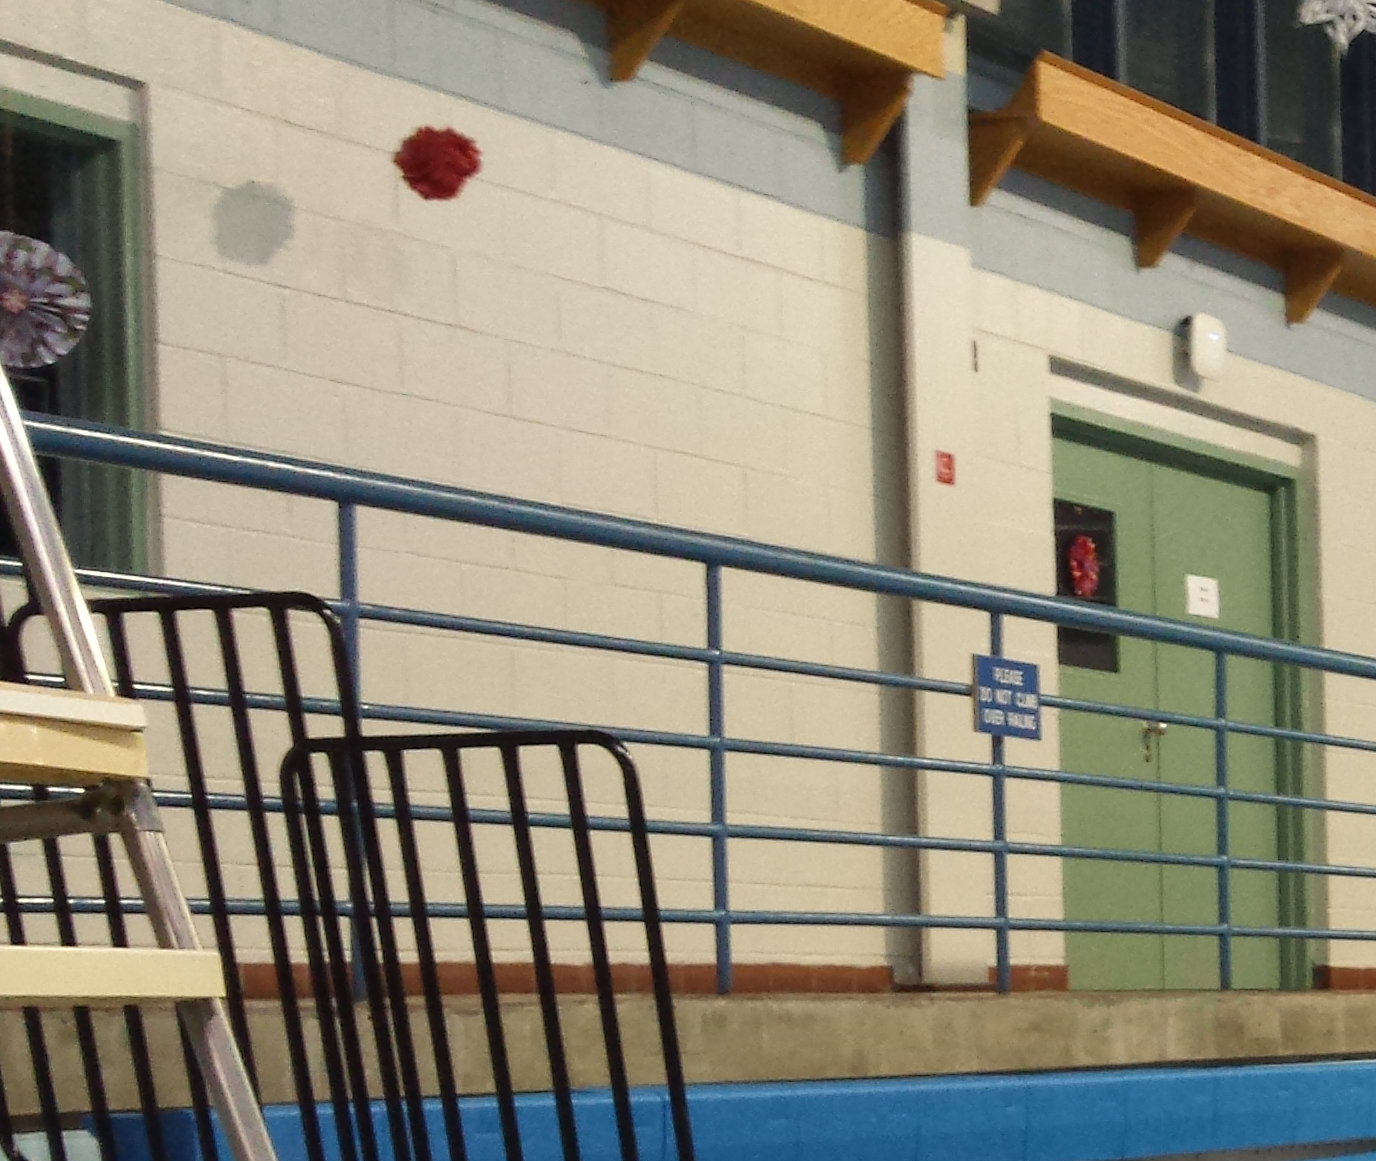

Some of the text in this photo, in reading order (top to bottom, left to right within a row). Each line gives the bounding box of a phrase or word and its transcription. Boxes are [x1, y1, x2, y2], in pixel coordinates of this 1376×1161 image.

[992, 666, 1024, 687] PLEASE
[980, 686, 993, 702] DO
[995, 689, 1012, 706] NOT
[984, 709, 1005, 726] OVER
